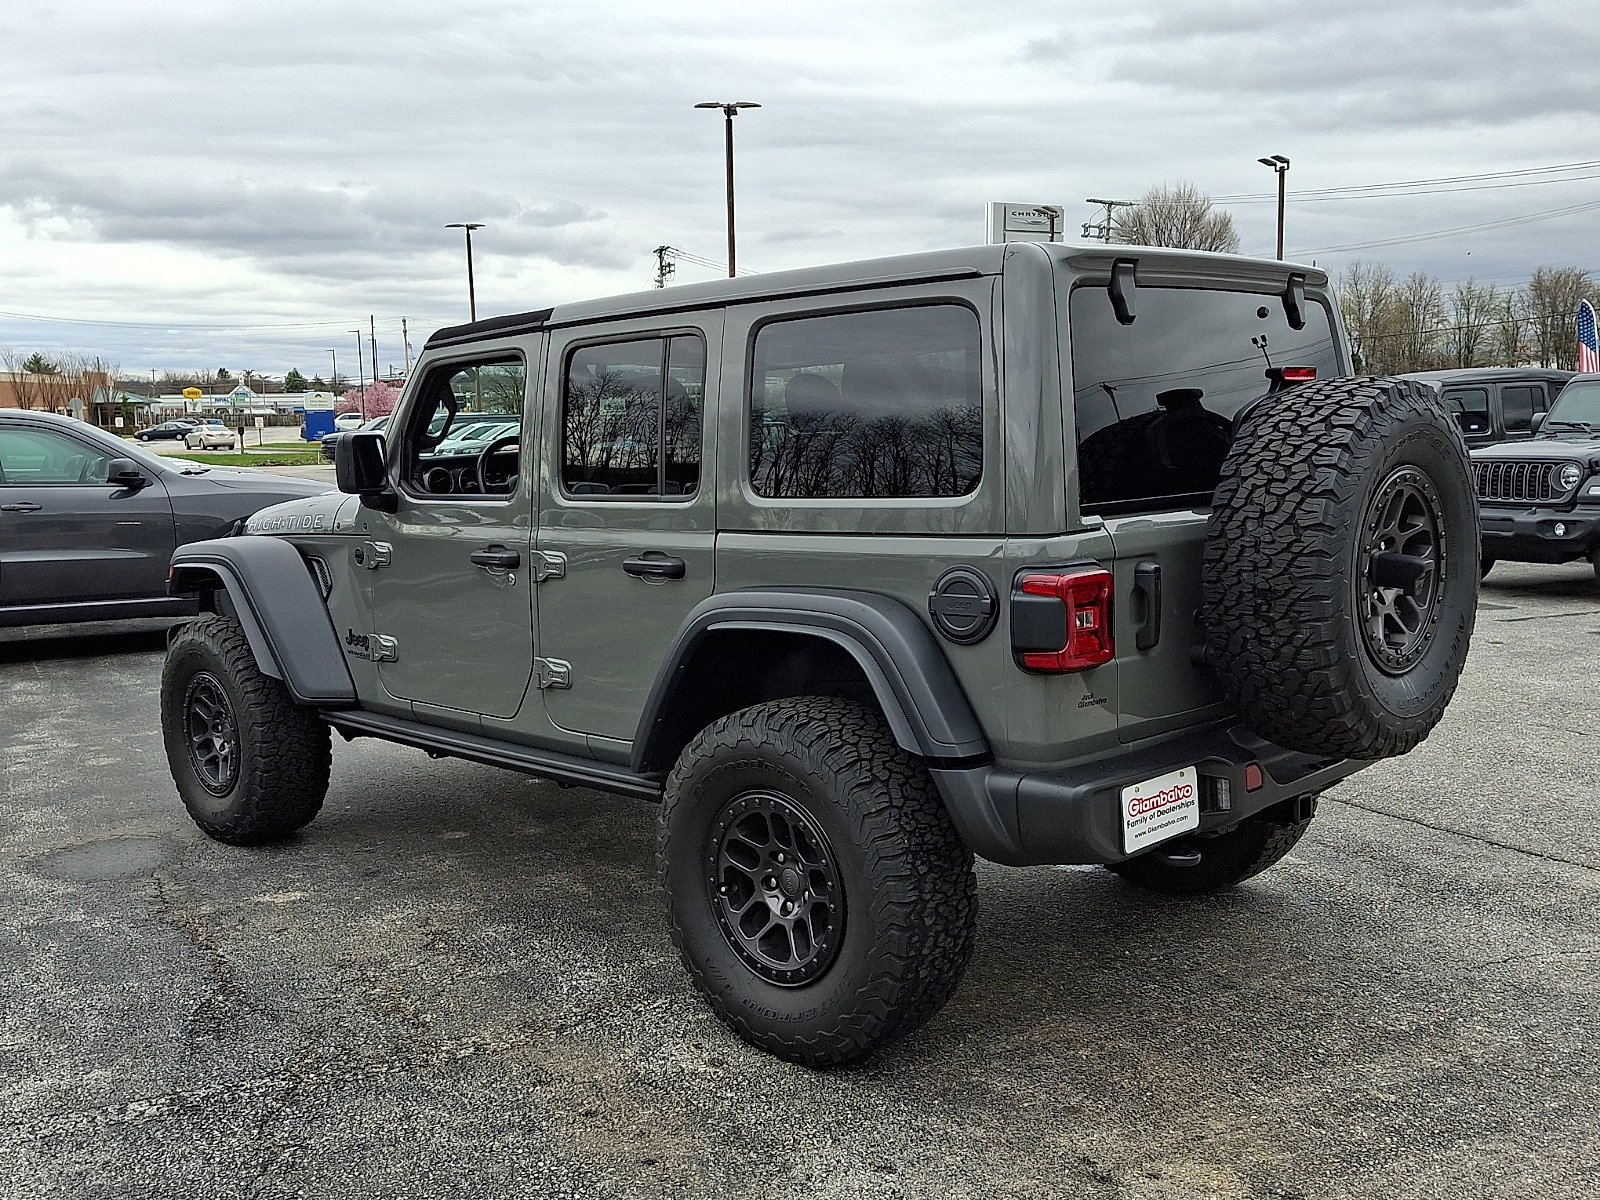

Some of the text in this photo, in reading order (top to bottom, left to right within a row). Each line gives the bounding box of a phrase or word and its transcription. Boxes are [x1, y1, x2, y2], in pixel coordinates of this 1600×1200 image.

[247, 513, 325, 532] HIGH TIDE
[345, 628, 370, 652] Jeep
[1126, 799, 1195, 829] Family of Dealerships
[1128, 784, 1193, 817] Giambalvo
